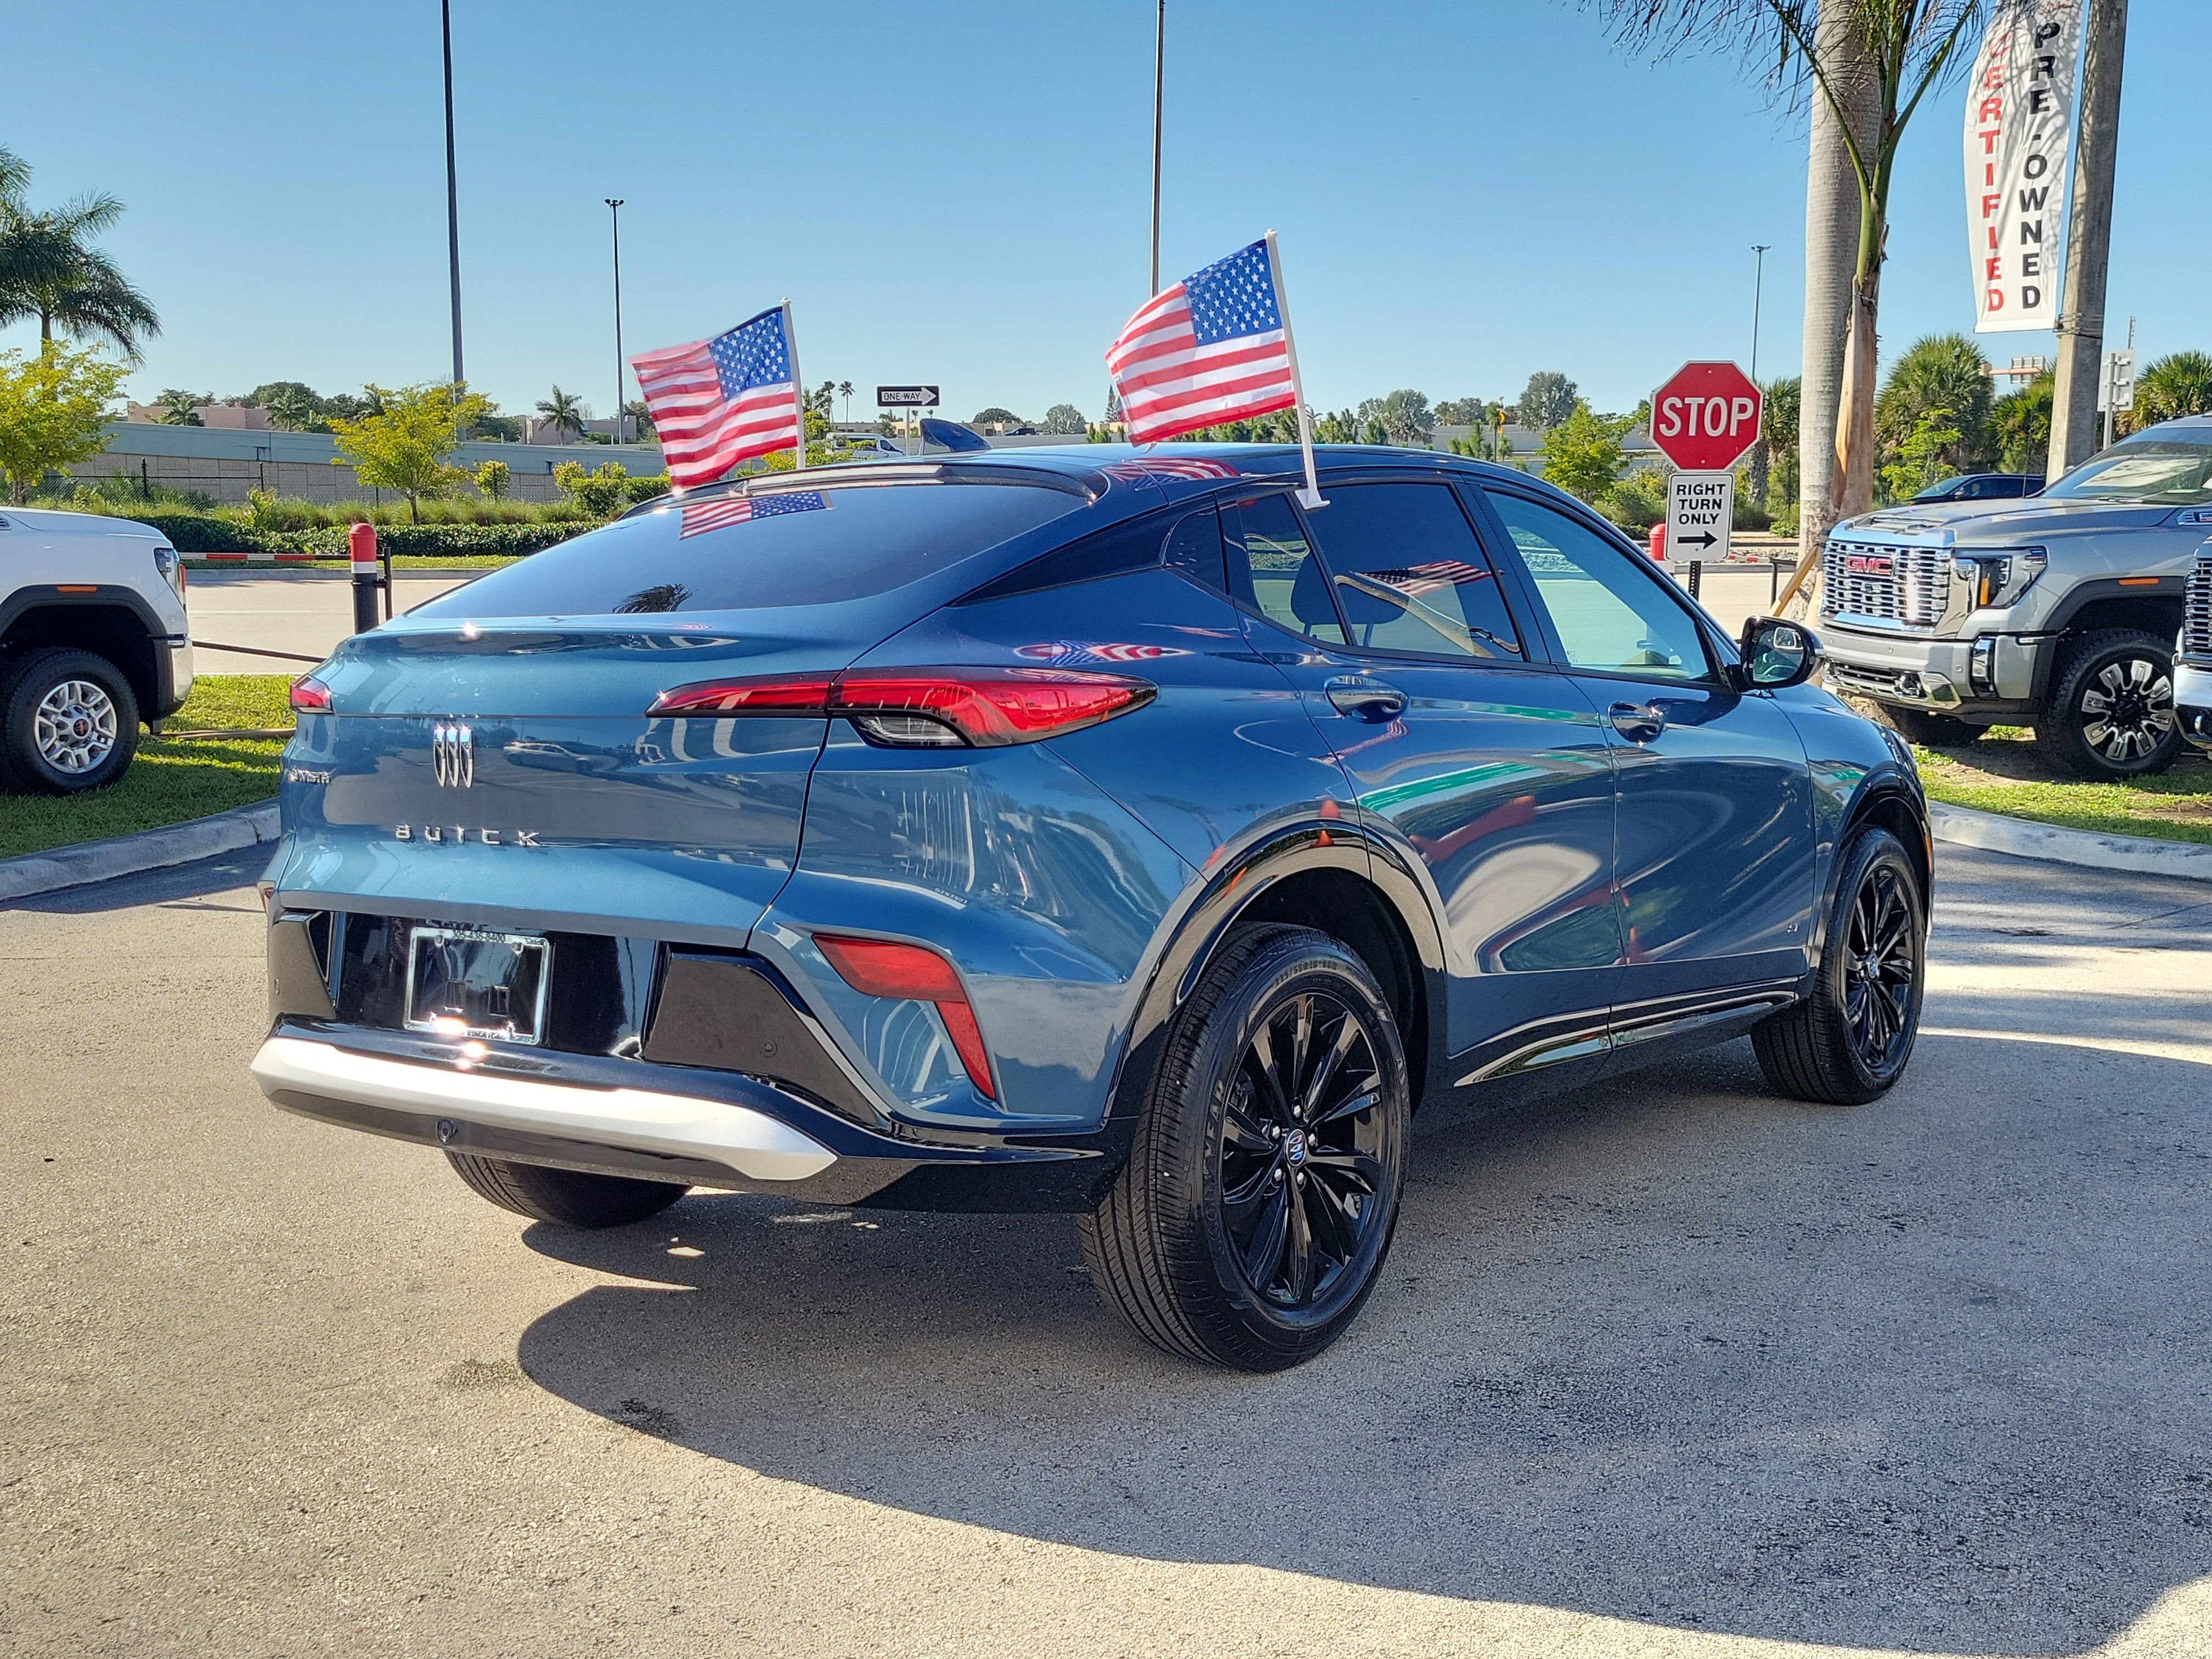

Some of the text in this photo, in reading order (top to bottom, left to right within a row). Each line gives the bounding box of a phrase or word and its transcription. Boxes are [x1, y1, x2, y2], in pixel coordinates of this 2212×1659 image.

[1978, 31, 2013, 311] CERTIFIED
[2019, 22, 2060, 309] PRE-OWNED
[884, 392, 921, 400] ONE WAY
[1659, 397, 1754, 437] STOP
[1677, 484, 1726, 495] RIGHT
[1678, 499, 1722, 510] TURN
[1678, 514, 1719, 524] ONLY
[1846, 556, 1892, 575] GMC
[396, 823, 540, 847] BUICK
